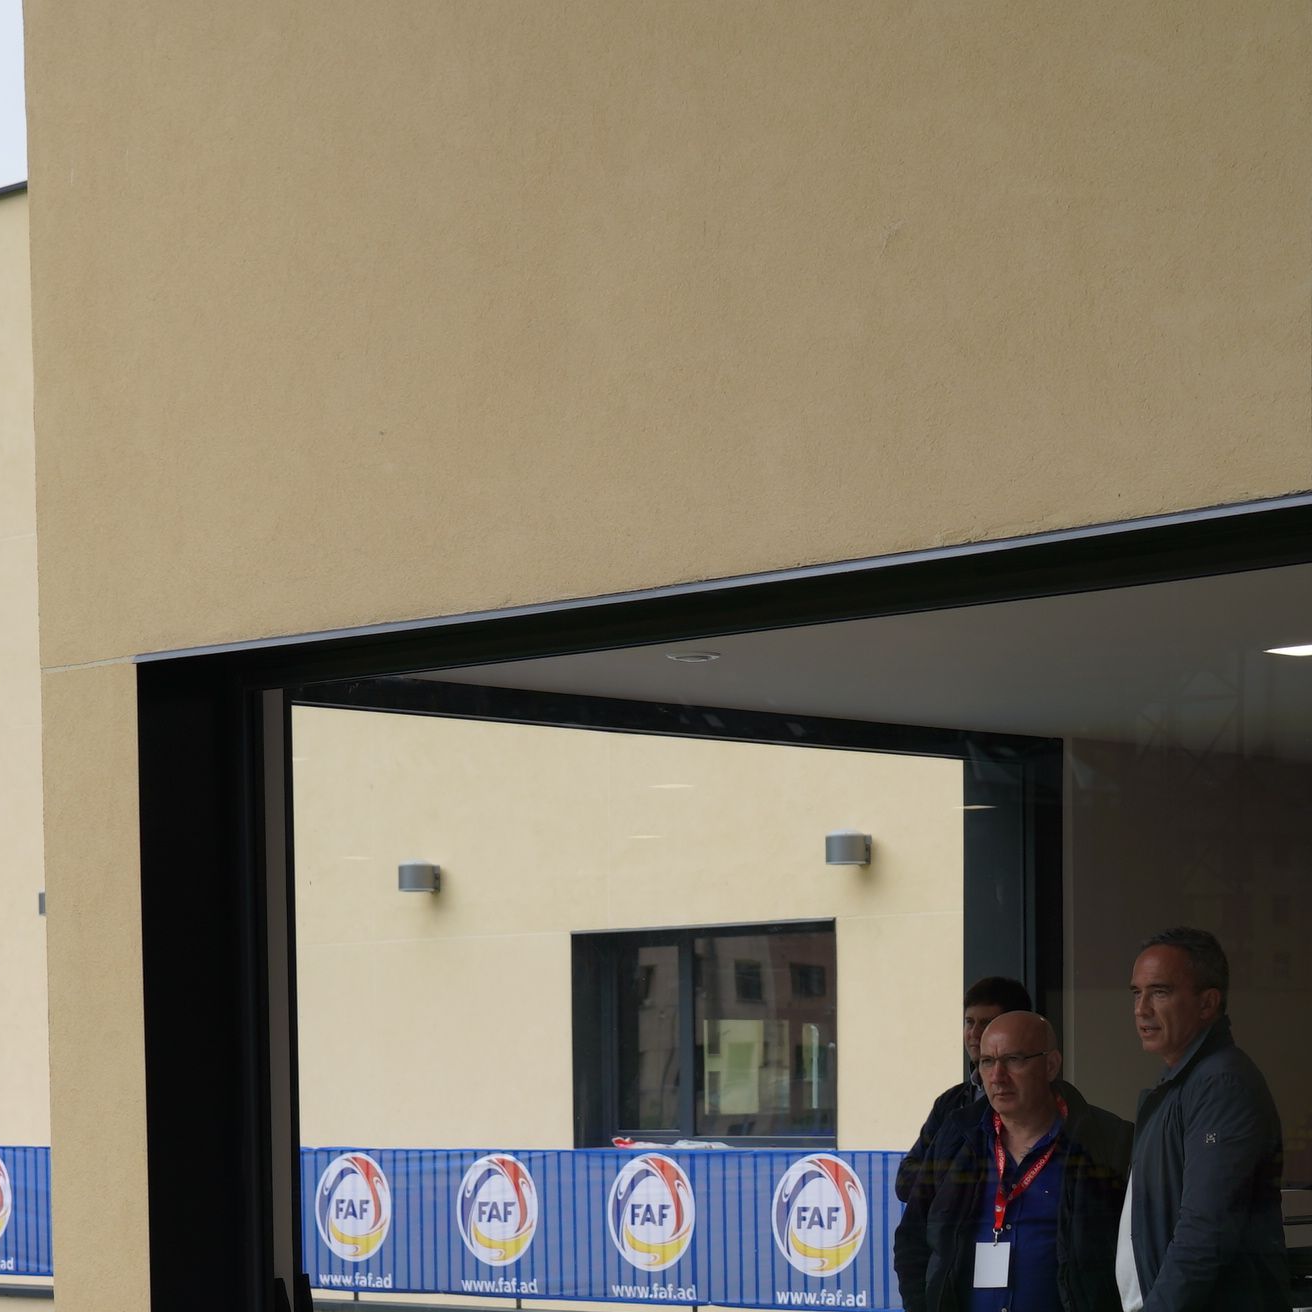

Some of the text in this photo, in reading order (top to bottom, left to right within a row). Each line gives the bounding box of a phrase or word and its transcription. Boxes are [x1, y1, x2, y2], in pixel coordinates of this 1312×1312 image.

[335, 1198, 370, 1220] FAF
[478, 1201, 516, 1223] FAF
[631, 1203, 670, 1227] FAF
[796, 1206, 840, 1230] FAF
[319, 1272, 392, 1289] www.faf.ad
[461, 1277, 538, 1294] www.faf.ad
[612, 1282, 697, 1301] www.faf.ad
[776, 1288, 866, 1307] www.faf.ad
